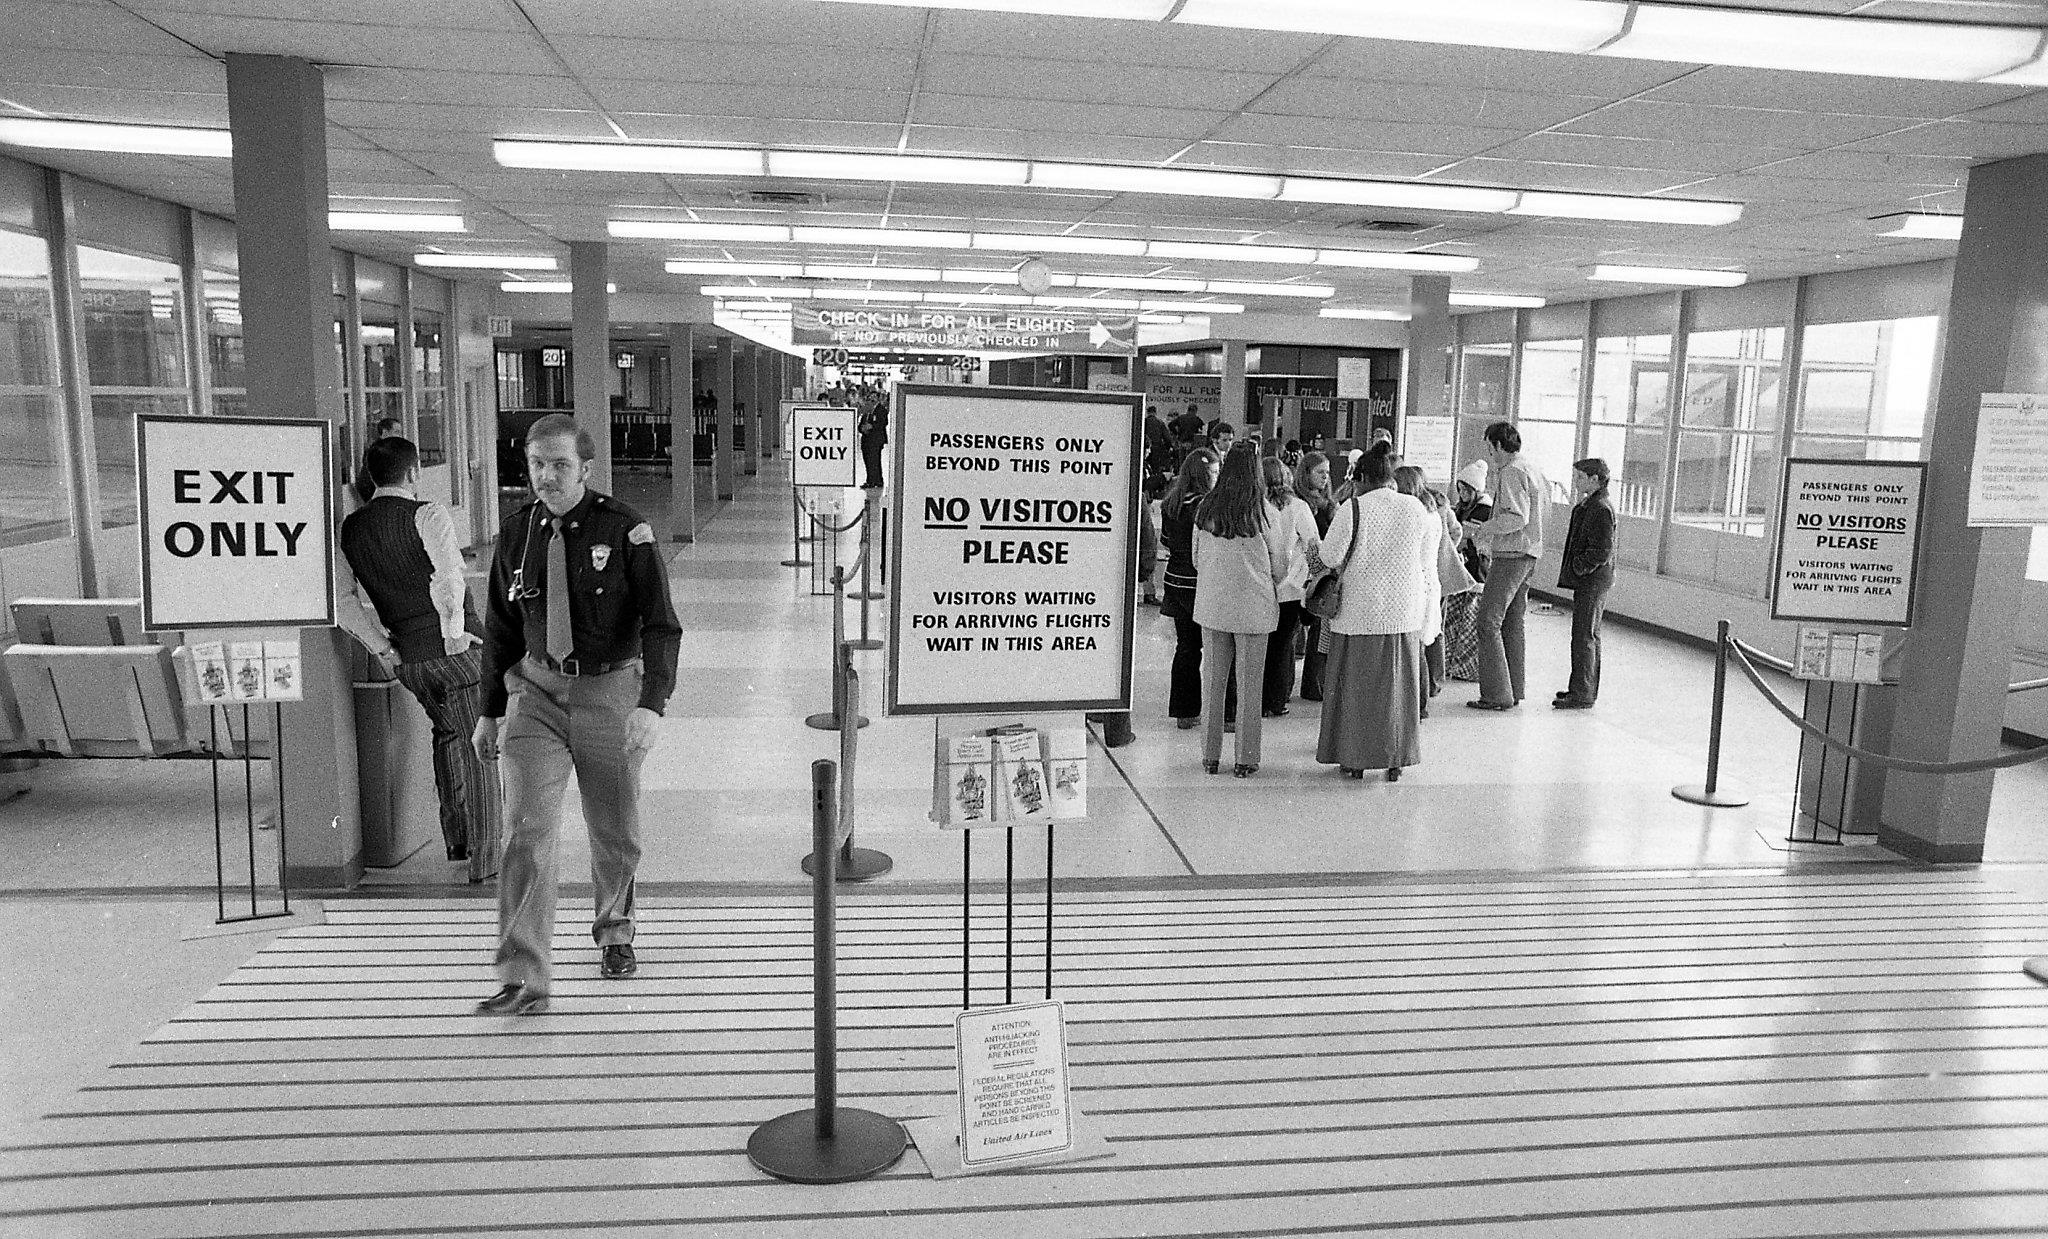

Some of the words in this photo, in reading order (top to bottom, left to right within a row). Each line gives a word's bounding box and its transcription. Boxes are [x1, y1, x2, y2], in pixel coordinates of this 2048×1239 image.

[921, 314, 956, 329] FOR
[966, 316, 996, 330] ALL
[1006, 317, 1075, 333] FLIGHTS
[833, 331, 847, 341] IF
[855, 331, 880, 342] NOT
[889, 332, 969, 344] PREVIOUSLY
[976, 336, 1038, 347] CHECKED
[1046, 337, 1059, 348] IN
[543, 352, 559, 363] 20
[822, 349, 849, 365] 20
[951, 357, 972, 370] 28
[1152, 385, 1173, 394] FOR
[1178, 386, 1195, 395] ALL
[1371, 391, 1395, 417] ited
[803, 427, 844, 441] EXIT
[930, 433, 1045, 451] PASSENGERS
[1055, 437, 1104, 453] ONLY
[800, 446, 848, 460] ONLY
[926, 456, 1000, 471] BEYOND
[1010, 458, 1050, 473] THIS
[1060, 460, 1113, 475] POINT
[174, 469, 294, 504] EXIT
[1802, 482, 1868, 492] PASSENGERS
[1874, 484, 1904, 493] ONLY
[1799, 493, 1841, 502] BEYOND
[1847, 494, 1870, 503] THIS
[1876, 496, 1908, 505] POINT
[924, 496, 971, 522] NO
[980, 498, 1113, 524] VISITORS
[1796, 513, 1823, 527] NO
[1828, 514, 1907, 530] VISITORS
[164, 521, 307, 558] ONLY
[1816, 535, 1879, 550] PLEASE
[963, 540, 1069, 565] PLEASE
[1798, 560, 1846, 570] VISITORS
[1850, 562, 1893, 572] WAITING
[1786, 571, 1806, 579] FOR
[1809, 573, 1857, 582] ARRIVING
[1861, 575, 1902, 585] FLIGHTS
[1792, 583, 1819, 592] WAIT
[1823, 584, 1834, 592] IN
[1838, 585, 1859, 594] THIS
[1864, 587, 1892, 596] AREA
[933, 591, 1017, 606] VISITORS
[1024, 591, 1096, 605] WAITING
[912, 614, 948, 629] FOR
[954, 614, 1038, 629] ARRIVING
[1046, 614, 1111, 628] FLIGHTS
[926, 637, 973, 652] WAIT
[981, 637, 999, 651] IN
[1005, 636, 1043, 651] THIS
[1051, 636, 1097, 651] AREA
[991, 1020, 1031, 1031] ATTENTION
[988, 1040, 1036, 1051] PROCEDURES
[988, 1051, 1002, 1060] ARE
[1012, 1046, 1038, 1057] EFFECT
[972, 1075, 1005, 1085] FEDERAL
[1006, 1067, 1055, 1080] REGULATIONS
[974, 1091, 1009, 1102] PERSONS
[1010, 1087, 1039, 1098] BEYOND
[1040, 1084, 1055, 1092] THIS
[982, 1081, 1014, 1093] REQUIRE
[1016, 1079, 1032, 1087] THAT
[980, 1101, 1002, 1110] POINT
[1015, 1094, 1051, 1105] SCREENED
[982, 1110, 997, 1118] AND
[999, 1107, 1019, 1116] HAND
[1020, 1101, 1051, 1113] CARRIED
[973, 1116, 1009, 1128] ARTICLES
[1021, 1108, 1060, 1120] INSPECTED
[983, 1135, 1012, 1145] United
[1014, 1131, 1027, 1140] Air
[1028, 1129, 1053, 1139] Lines
